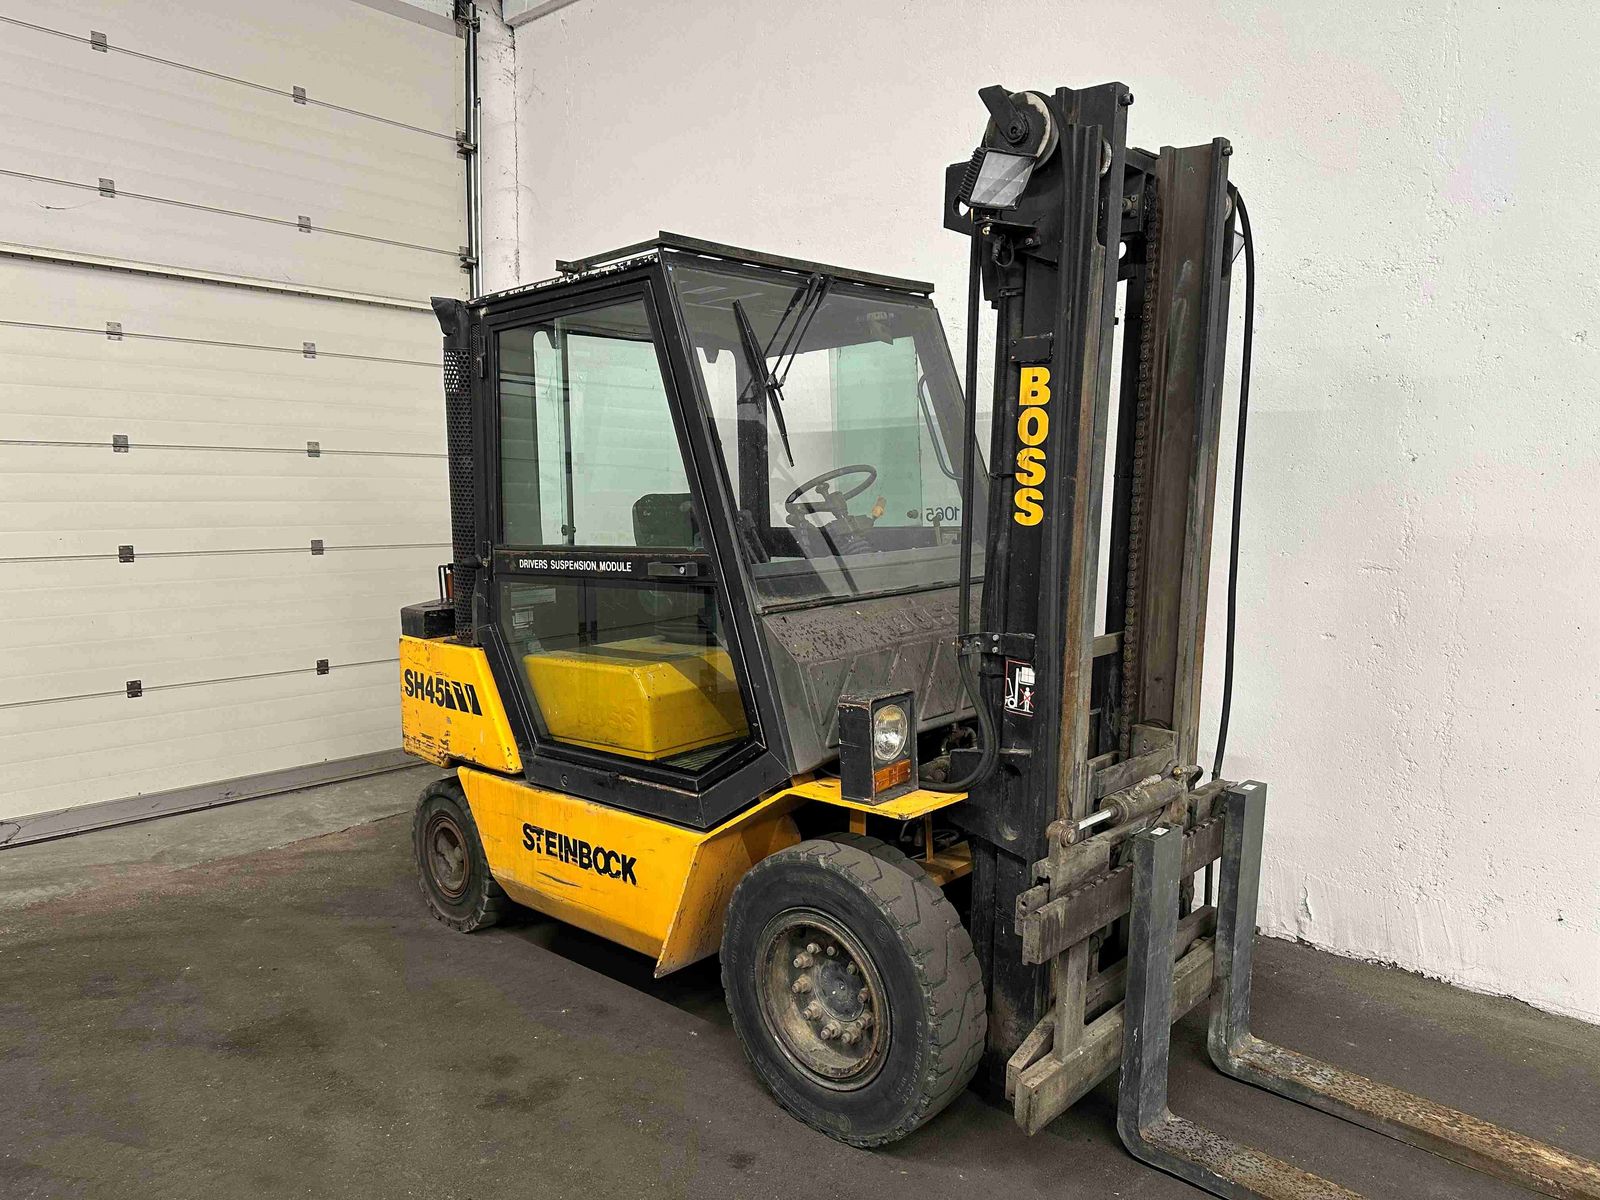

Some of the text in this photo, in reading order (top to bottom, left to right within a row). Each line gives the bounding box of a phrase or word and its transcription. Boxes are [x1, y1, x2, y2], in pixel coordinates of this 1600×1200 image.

[1014, 366, 1051, 527] BOSS
[519, 559, 632, 572] DRIVERS SUSPENSION MODULE
[404, 668, 445, 708] SH45
[522, 822, 637, 886] STEINBOCK
